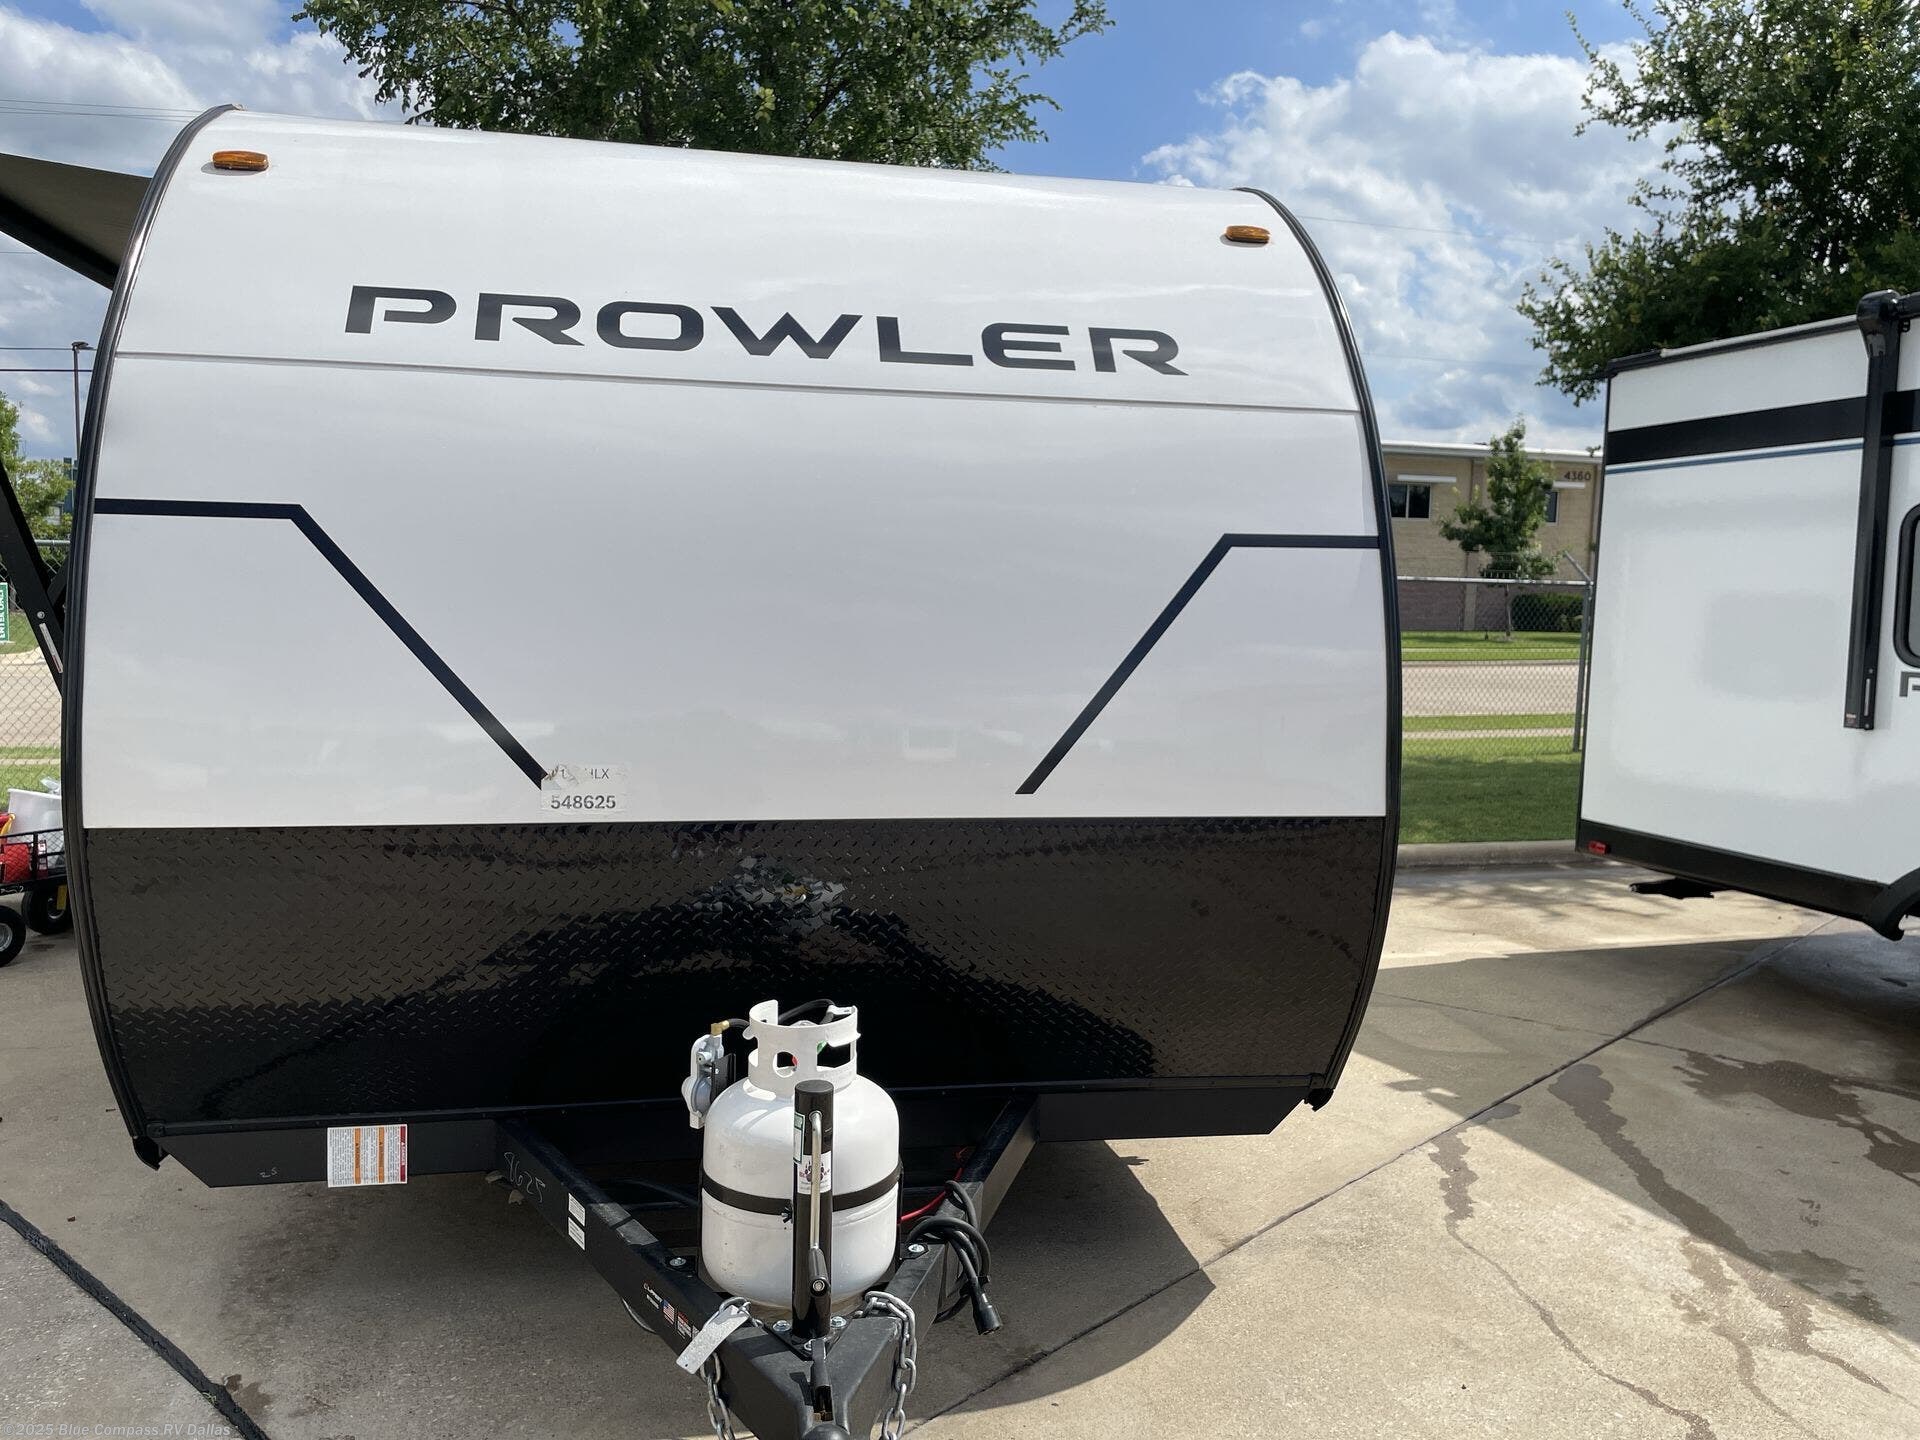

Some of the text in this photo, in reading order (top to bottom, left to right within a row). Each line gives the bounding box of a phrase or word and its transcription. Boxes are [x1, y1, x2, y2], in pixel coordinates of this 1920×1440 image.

[345, 285, 1189, 376] PROWLER
[1564, 471, 1592, 481] 4360
[550, 795, 616, 809] 548625
